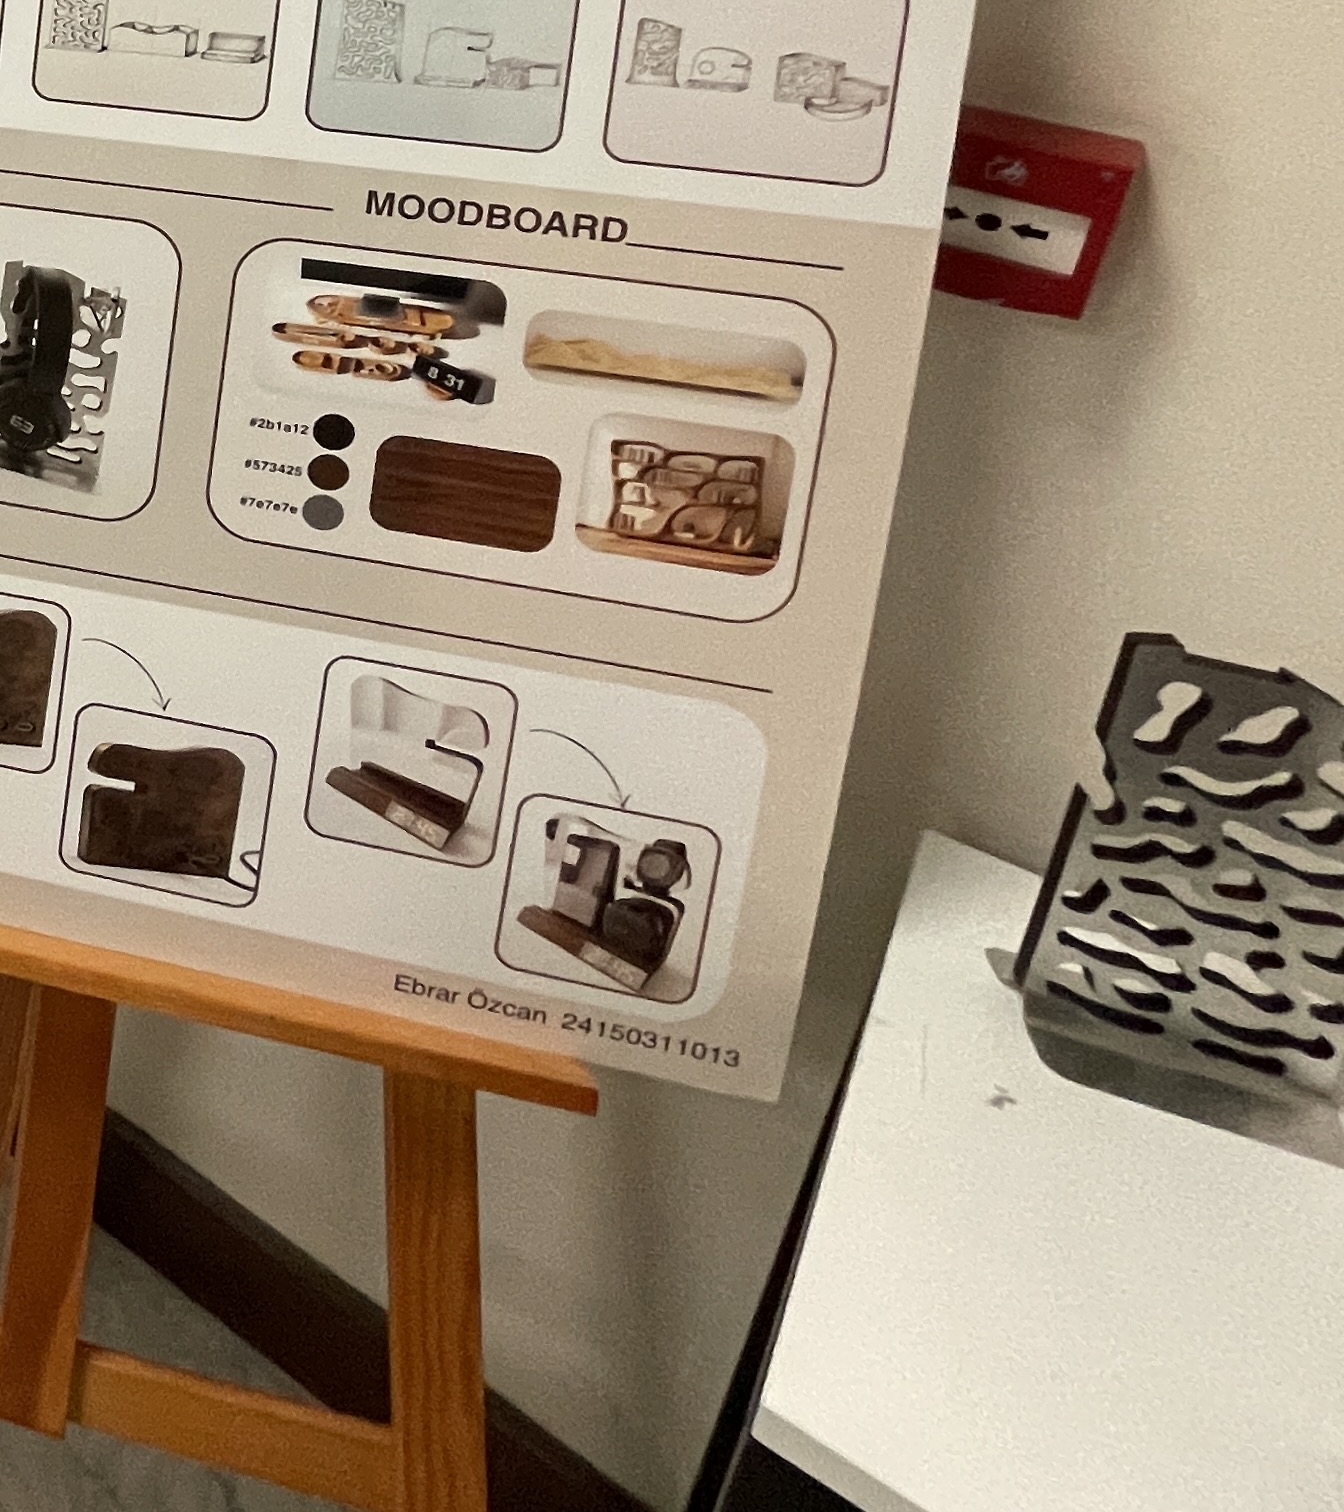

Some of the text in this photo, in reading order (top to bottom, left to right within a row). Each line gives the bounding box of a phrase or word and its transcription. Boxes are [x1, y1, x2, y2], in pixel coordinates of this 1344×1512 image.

[365, 189, 629, 244] MOODBOARD
[244, 459, 303, 477] #573425
[394, 973, 742, 1068] Ebrar Özcan 24150311013
